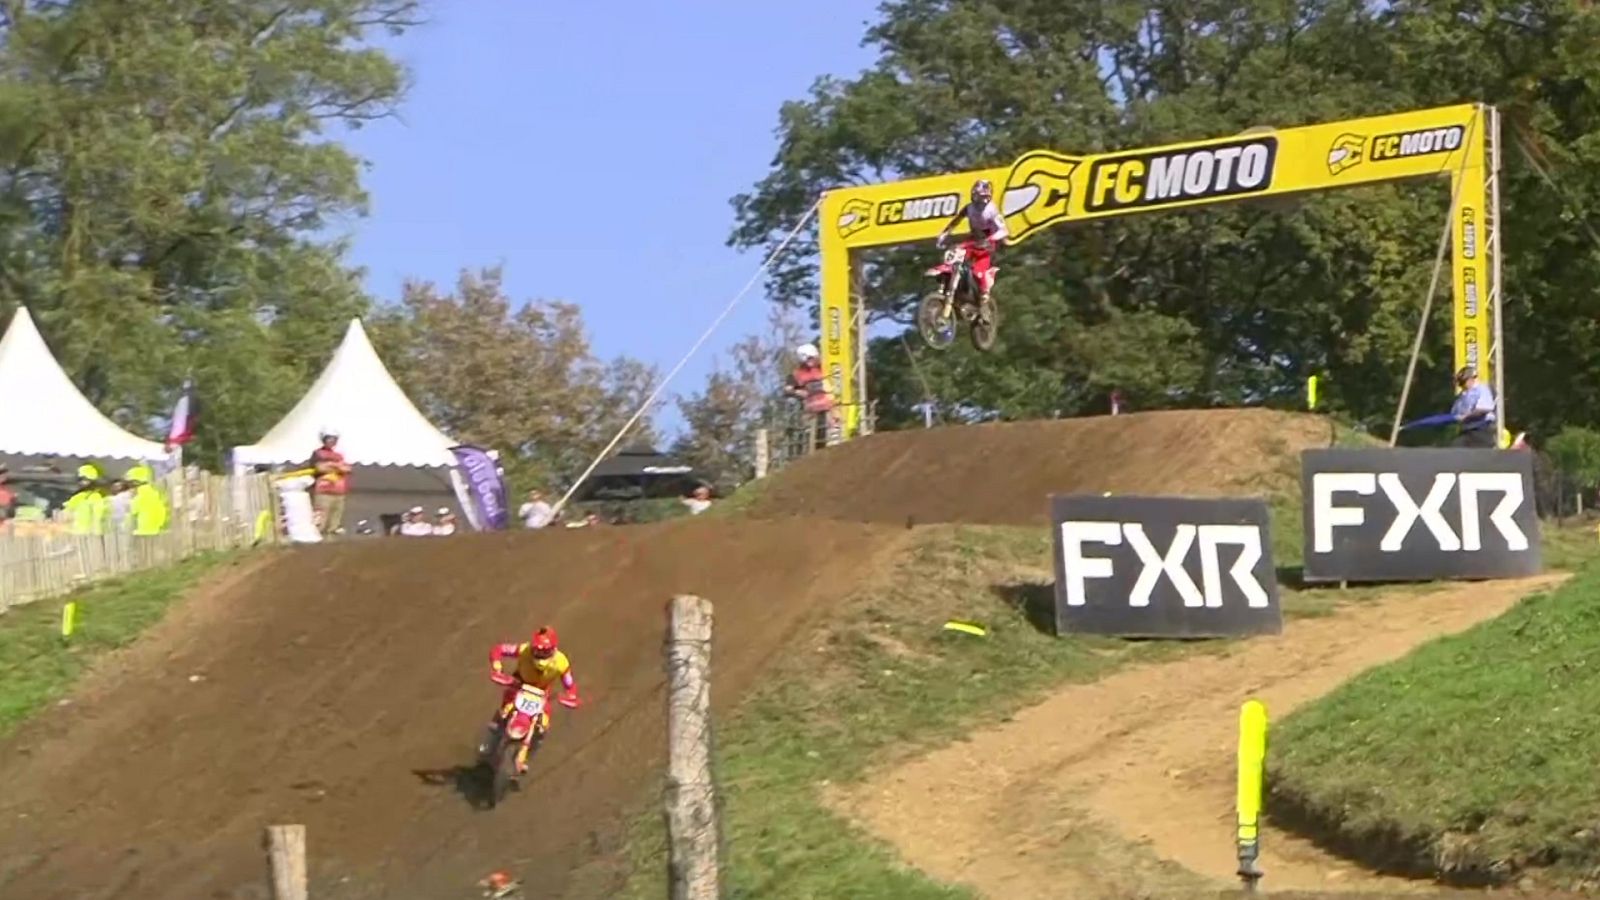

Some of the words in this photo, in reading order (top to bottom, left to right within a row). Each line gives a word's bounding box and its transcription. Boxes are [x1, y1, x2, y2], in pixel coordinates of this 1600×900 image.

[1091, 160, 1145, 207] FC
[1145, 143, 1269, 201] MOTO
[1313, 472, 1528, 553] FXR
[1061, 520, 1269, 608] FXR
